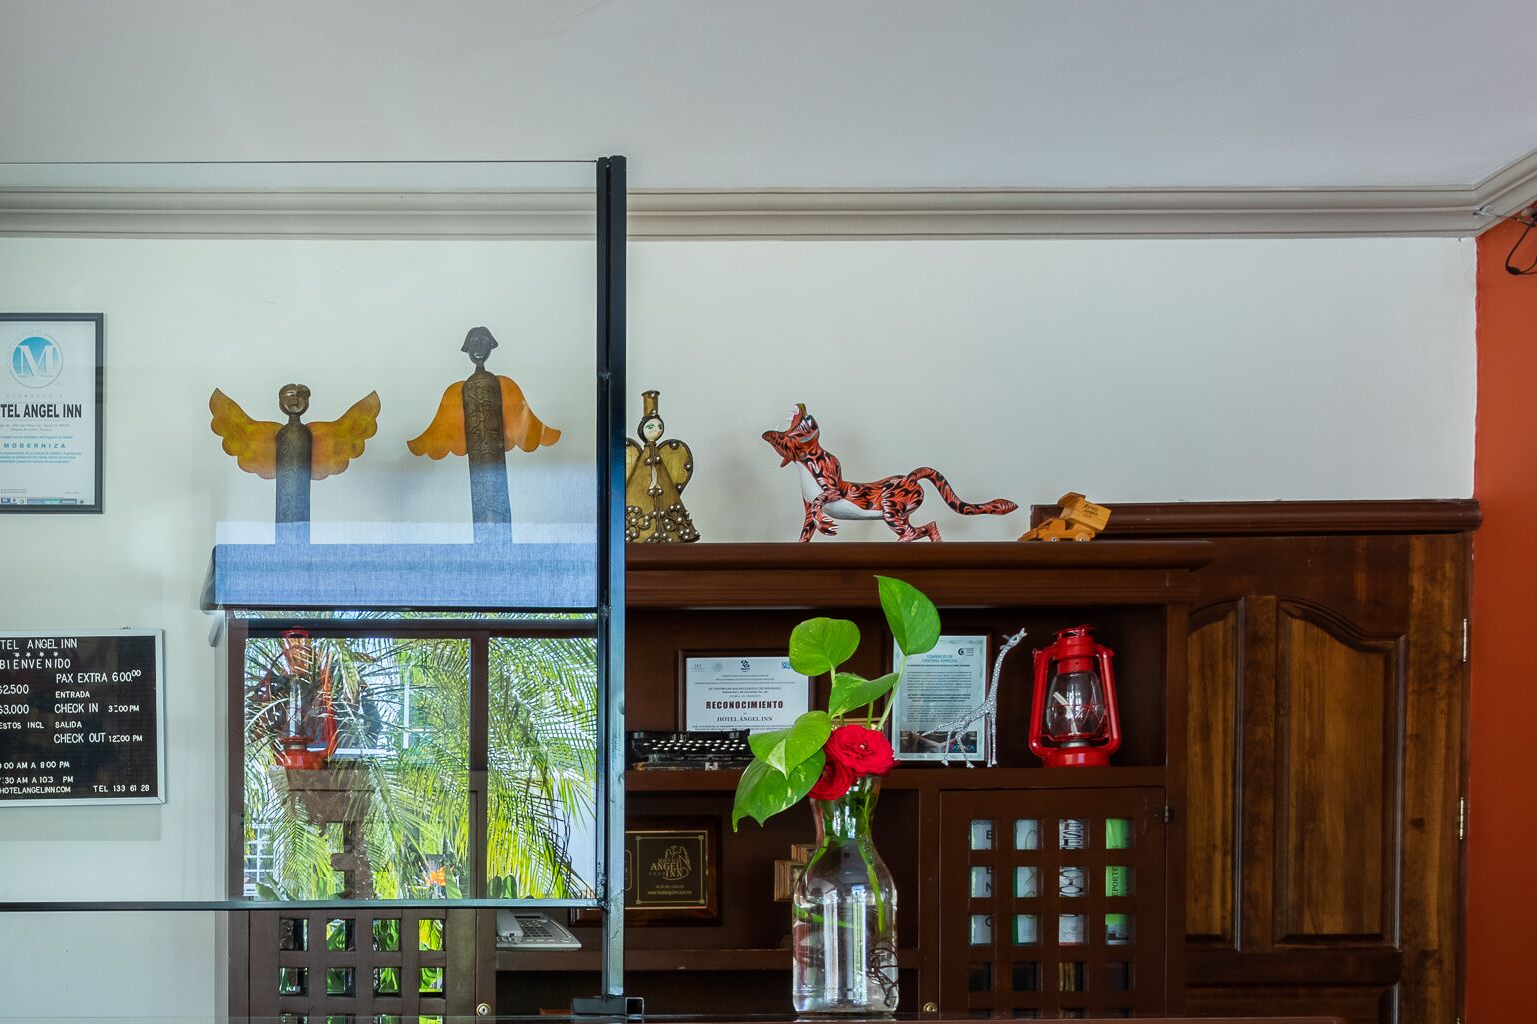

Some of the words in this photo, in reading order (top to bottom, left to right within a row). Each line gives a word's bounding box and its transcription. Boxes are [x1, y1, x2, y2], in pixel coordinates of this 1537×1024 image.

[23, 404, 60, 418] ANGEL
[63, 403, 82, 418] INN
[27, 639, 58, 649] ANGEL
[61, 638, 78, 648] INN
[0, 658, 71, 670] BIENVENIDO
[56, 673, 74, 683] PAX
[77, 672, 108, 683] EXTRA
[55, 690, 91, 699] ENTRADA
[54, 703, 85, 714] CHECK
[88, 702, 99, 713] IN
[129, 704, 140, 712] PM
[706, 700, 784, 710] RECONOCIMIENTO
[27, 721, 45, 729] INCL
[54, 720, 83, 729] SALIDA
[53, 733, 85, 744] CHECK
[88, 732, 106, 743] OUT
[132, 734, 143, 742] PM
[30, 761, 37, 769] A
[59, 760, 70, 769] PM
[16, 776, 29, 784] AM
[31, 776, 38, 784] A
[62, 775, 74, 783] PM
[93, 785, 109, 793] TEL
[113, 784, 126, 792] 133
[129, 784, 137, 792] 61
[140, 784, 150, 792] 28
